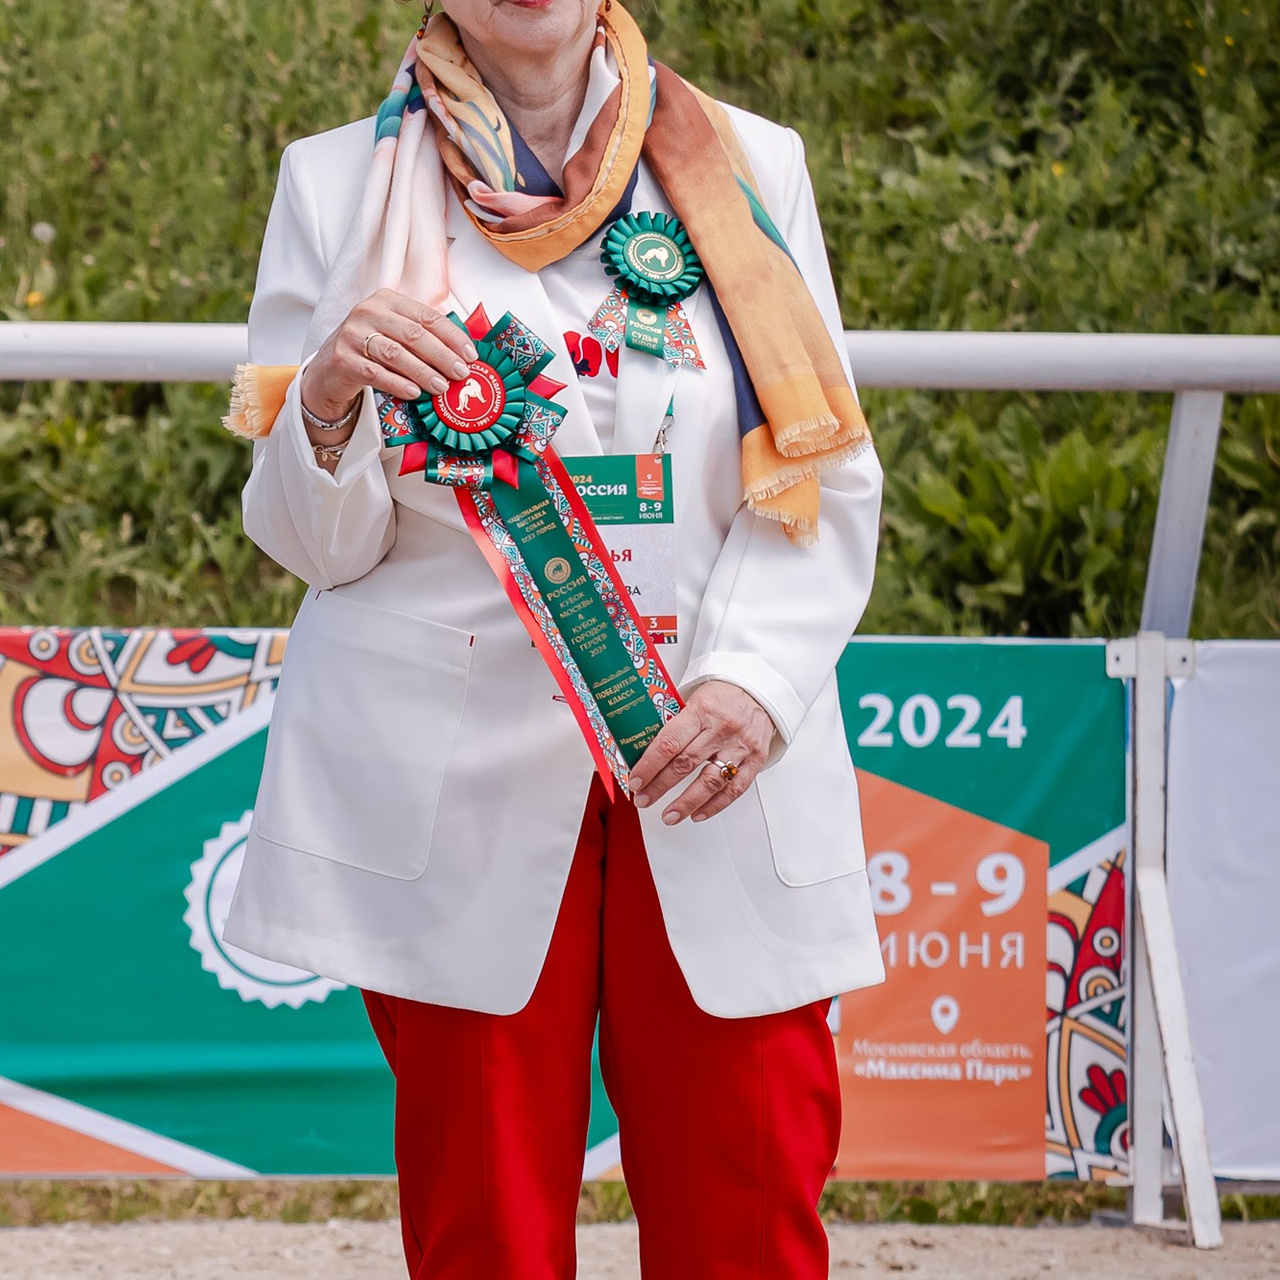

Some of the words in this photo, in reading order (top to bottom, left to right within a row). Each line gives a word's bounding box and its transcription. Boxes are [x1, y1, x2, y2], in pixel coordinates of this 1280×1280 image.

[629, 320, 662, 334] РОССИЯ
[631, 331, 658, 344] СУДЬЯ
[639, 501, 663, 513] 8-9
[516, 510, 547, 528] ВЫСТАВКА
[638, 512, 663, 520] ИЮНЯ
[525, 519, 545, 533] СОБАК
[536, 522, 557, 536] ПОРОД
[546, 575, 587, 601] РОССИЯ
[558, 591, 585, 608] КУБОК
[559, 597, 594, 619] МОСКВЫ
[571, 616, 598, 634] КУБОК
[649, 617, 658, 629] 3
[579, 632, 608, 651] ГЕРОЕВ
[589, 644, 607, 658] 2024
[595, 675, 638, 700] ПОБЕДИТЕЛЬ
[607, 688, 635, 706] КЛАССА
[856, 692, 1028, 748] 2024
[619, 731, 646, 745] Максима
[852, 1038, 957, 1058] Московская
[854, 1058, 963, 1081] «Максима
[966, 1060, 1033, 1087] Парк»
